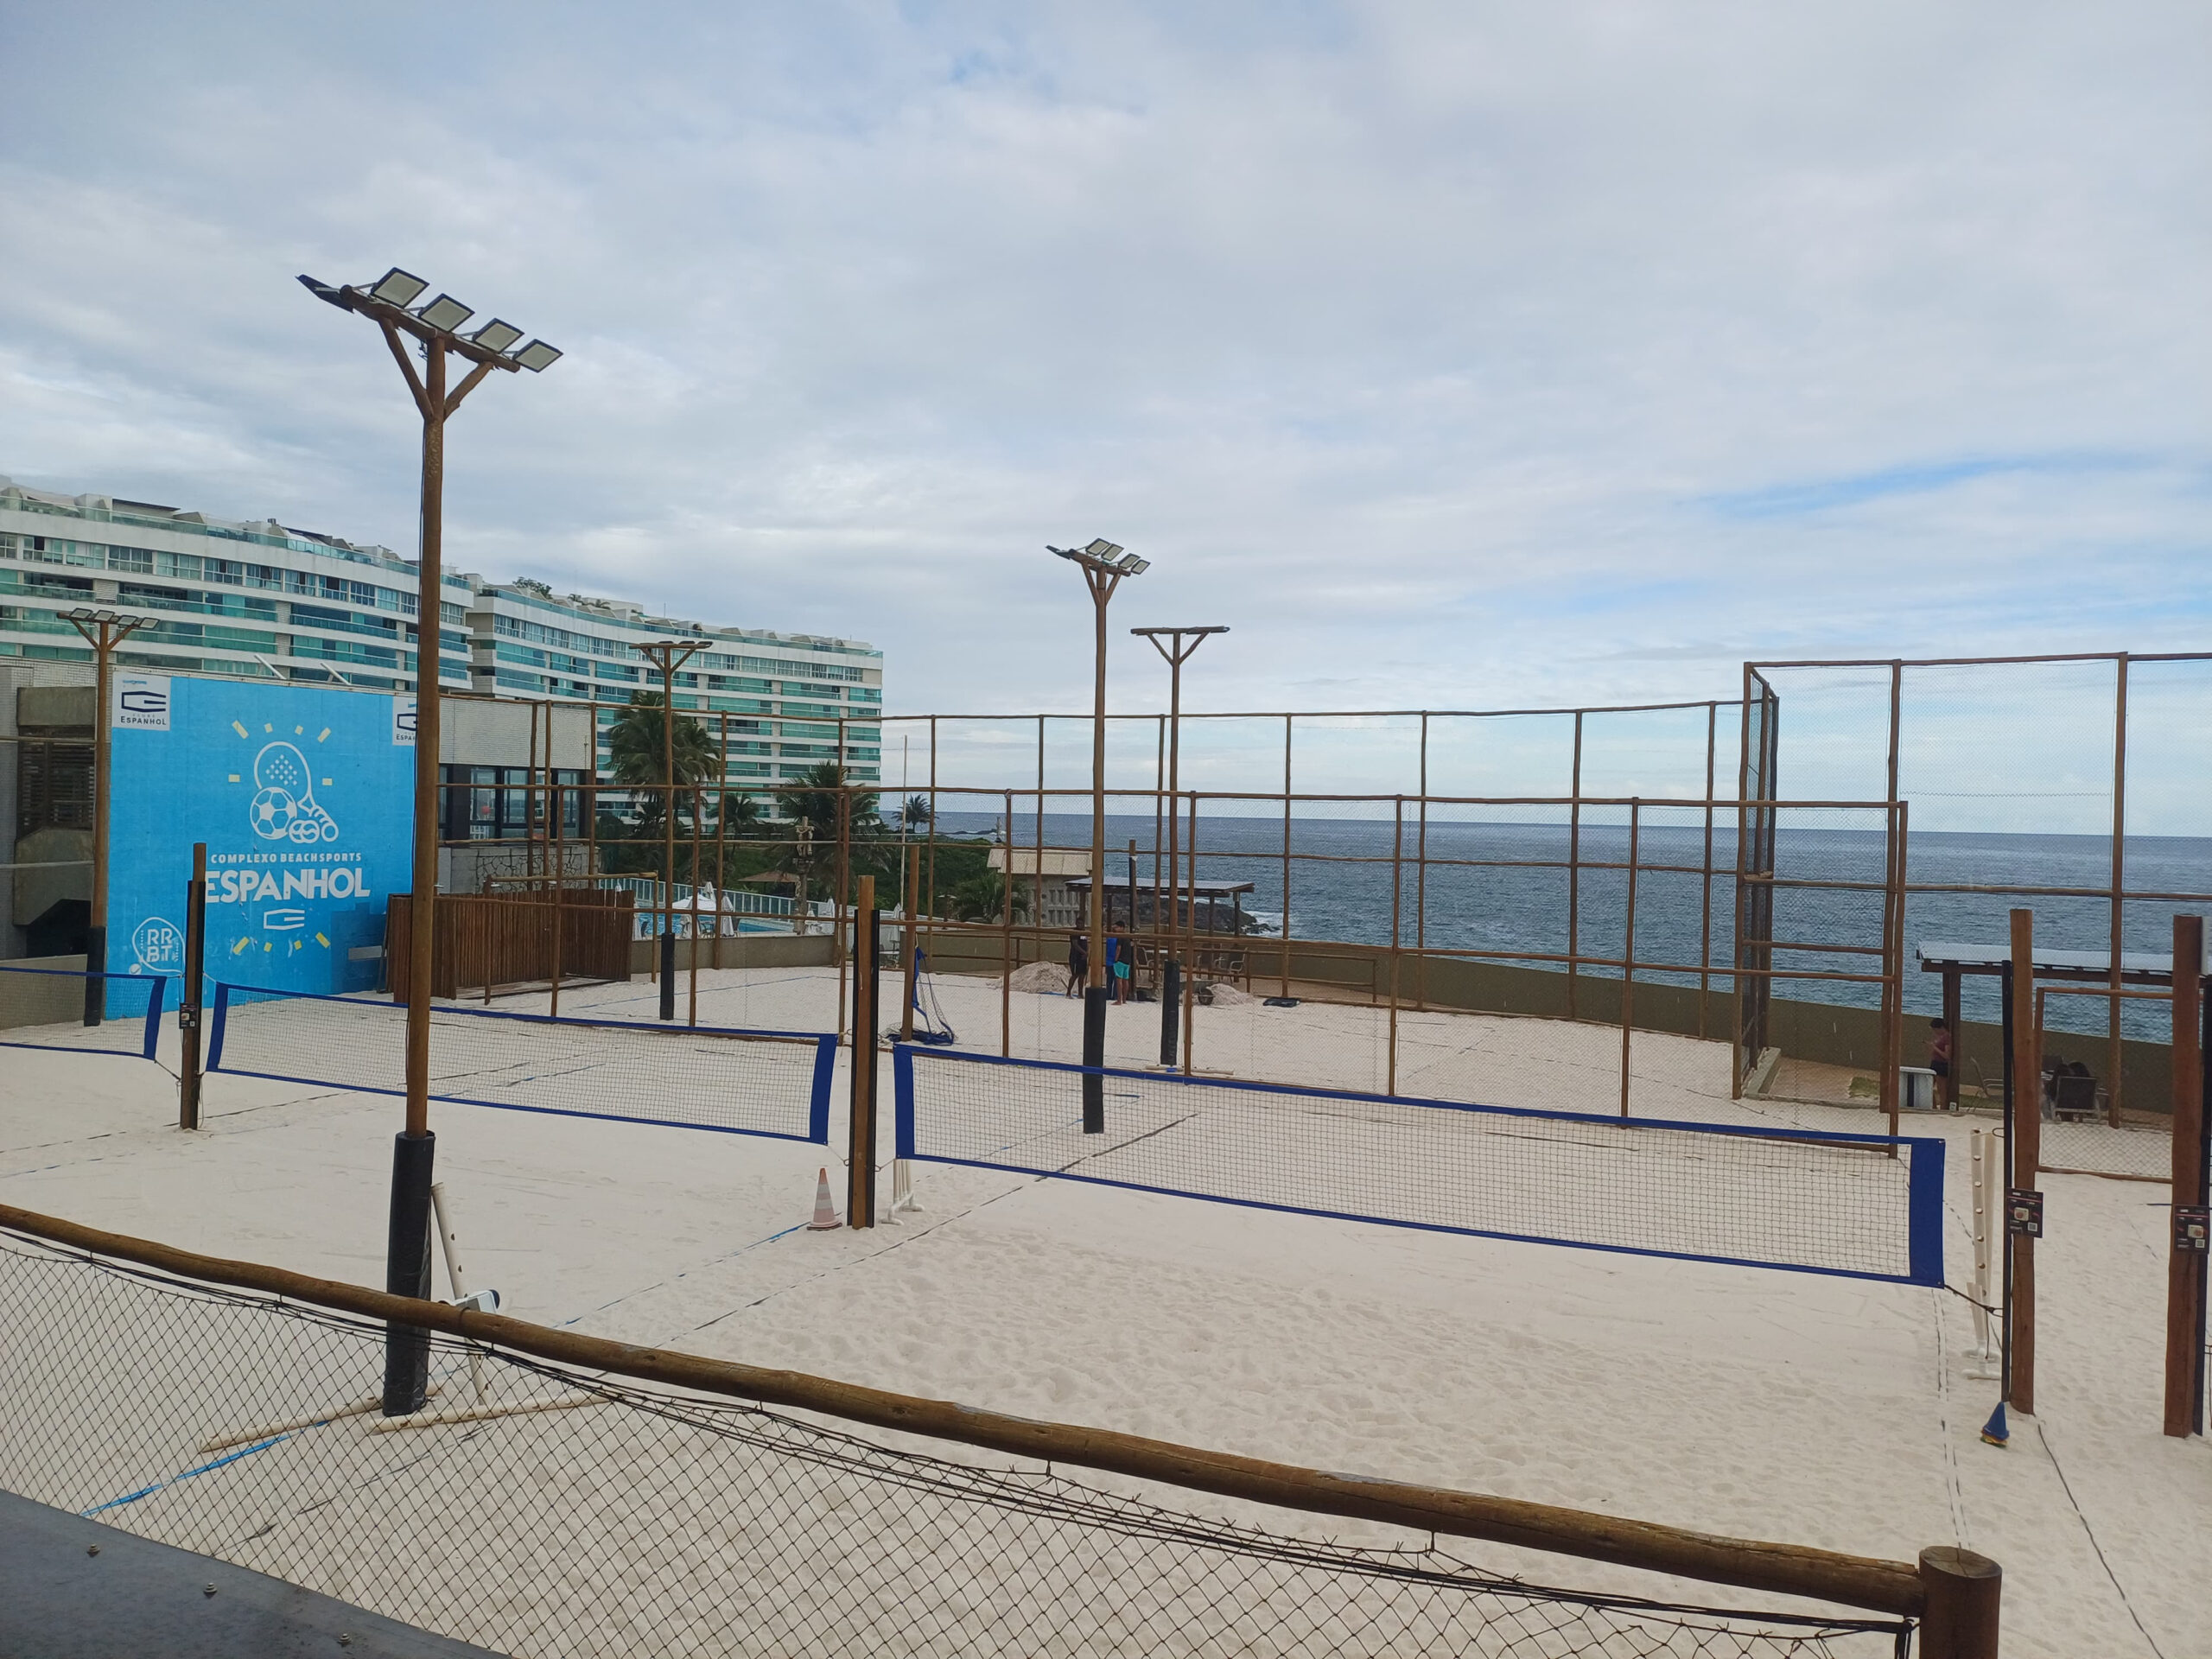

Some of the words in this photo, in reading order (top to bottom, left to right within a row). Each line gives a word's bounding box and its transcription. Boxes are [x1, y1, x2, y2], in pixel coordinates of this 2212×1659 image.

[120, 715, 167, 726] ESPANHOL
[211, 854, 277, 864] COMPLEXO
[205, 867, 372, 904] ESPANHOL
